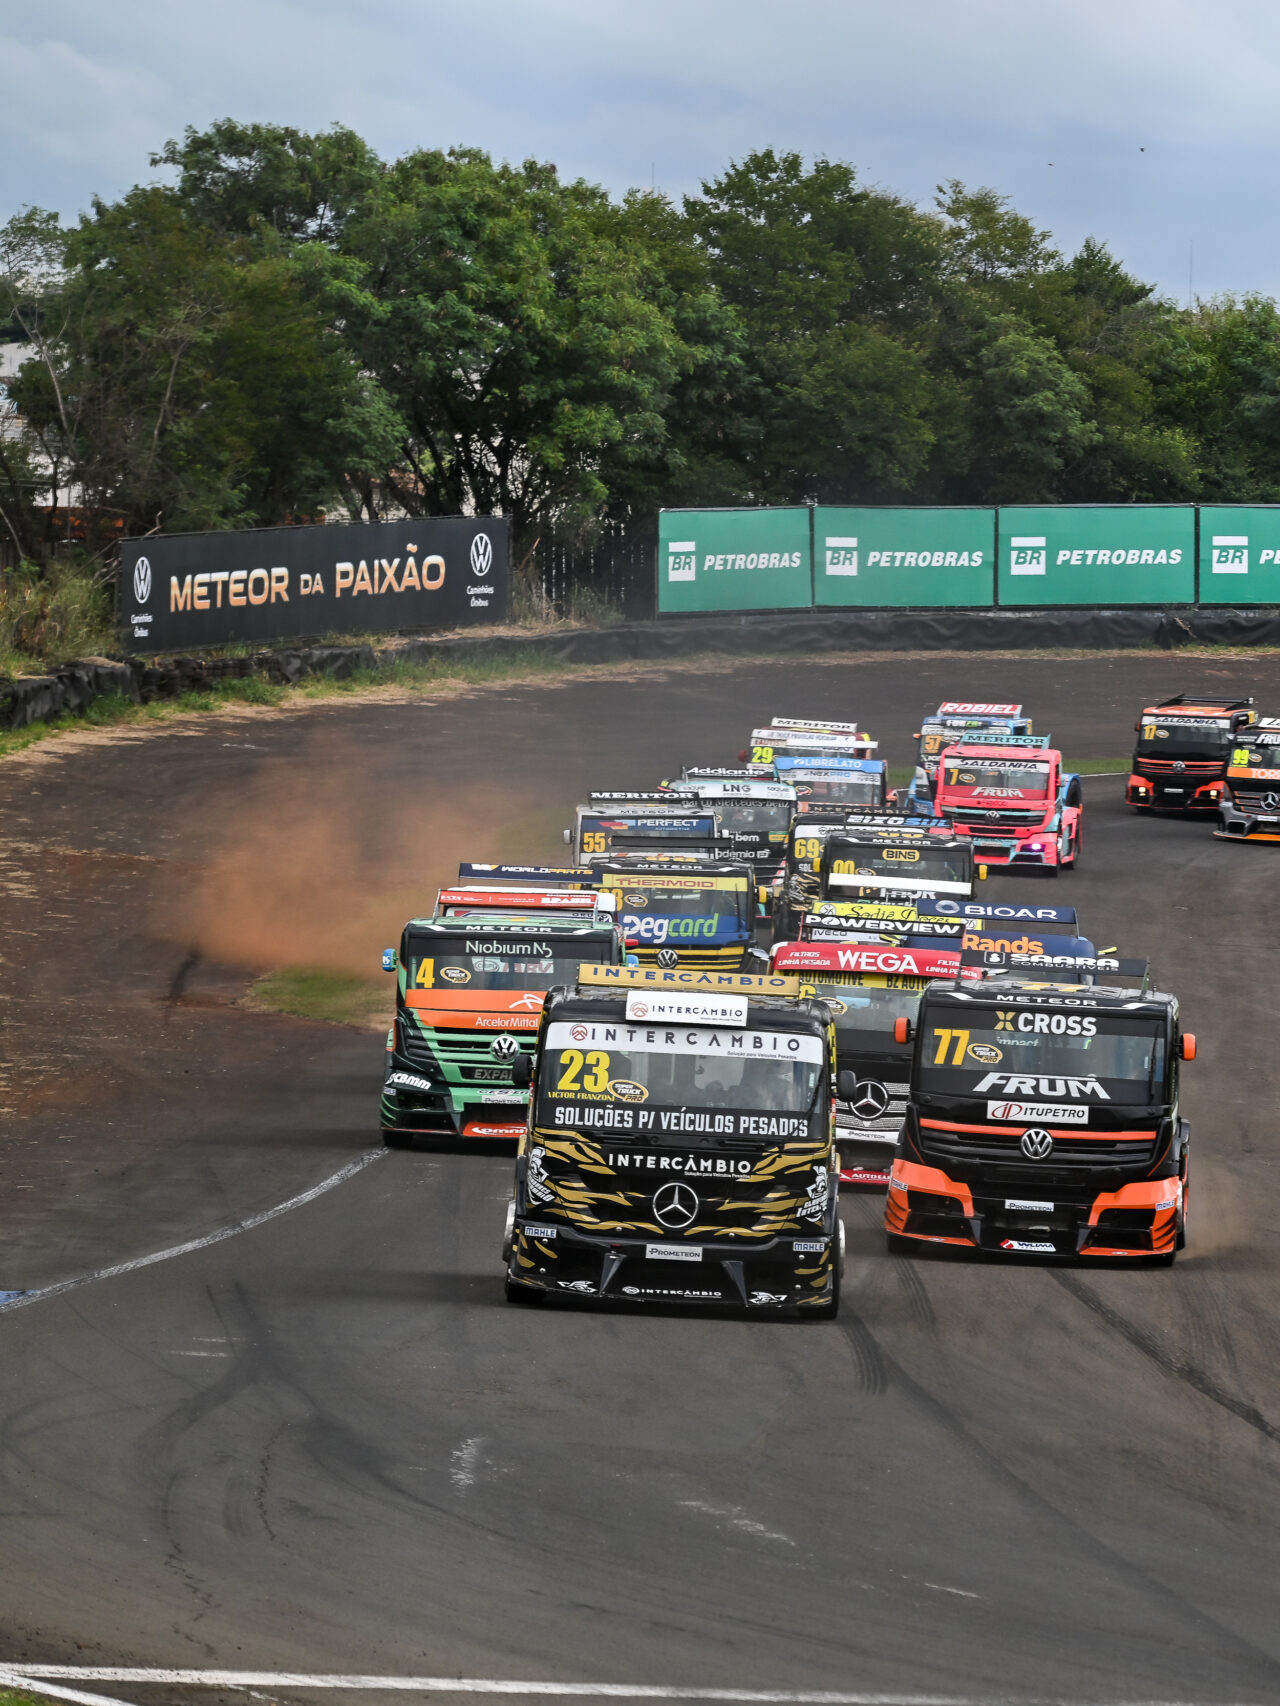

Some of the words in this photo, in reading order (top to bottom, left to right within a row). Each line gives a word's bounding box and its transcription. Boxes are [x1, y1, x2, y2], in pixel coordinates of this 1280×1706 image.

[703, 552, 801, 571] PETROBRAS
[867, 551, 983, 567] PETROBRAS
[1057, 549, 1182, 565] PETROBRAS
[169, 567, 289, 613] METEOR
[300, 573, 324, 595] DA
[335, 543, 446, 598] PAIXÃO
[942, 703, 1016, 713] ROBIEL
[776, 719, 852, 730] MERITOR
[925, 736, 942, 751] 57
[967, 735, 1045, 745] MERITOR
[751, 746, 774, 763] 29
[1233, 749, 1250, 765] 99
[805, 758, 862, 769] LIBRELATO
[960, 759, 1039, 770] SALDANHA
[949, 768, 959, 786] 7
[590, 791, 695, 799] MERITOR
[723, 784, 752, 792] LNG
[971, 786, 1025, 798] FRUM
[637, 819, 700, 827] PERFECT
[583, 832, 606, 853] 55
[794, 838, 820, 859] 69
[872, 838, 931, 846] METEOR
[886, 850, 916, 860] BINS
[501, 866, 594, 875] WORLDPARTS
[615, 877, 715, 888] THERMOID
[965, 905, 1059, 920] BIOAR
[466, 925, 552, 933] METEOR
[805, 914, 961, 934] POWERVIEW
[465, 939, 531, 954] Niobium
[837, 950, 919, 973] WEGA
[1010, 953, 1120, 968] SAARA
[416, 958, 436, 989] 4
[593, 967, 786, 987] INTERCÂMBIO
[997, 995, 1098, 1006] METEOR
[475, 1017, 538, 1028] ArcelorMittal
[933, 1028, 970, 1066] 77
[557, 1049, 610, 1093] 23
[972, 1072, 1111, 1100] FRUM
[548, 1091, 575, 1099] VICTOR
[1023, 1106, 1087, 1119] ITUPETRO
[555, 1105, 634, 1128] SOLUÇÕES
[638, 1111, 656, 1129] P/
[661, 1107, 735, 1133] VEÍCULOS
[739, 1116, 809, 1137] PESADOS
[608, 1154, 751, 1174] INTERCÂMBIO
[525, 1228, 556, 1238] MAHLE
[650, 1248, 701, 1258] PROMETEON
[794, 1243, 824, 1251] MAHLE
